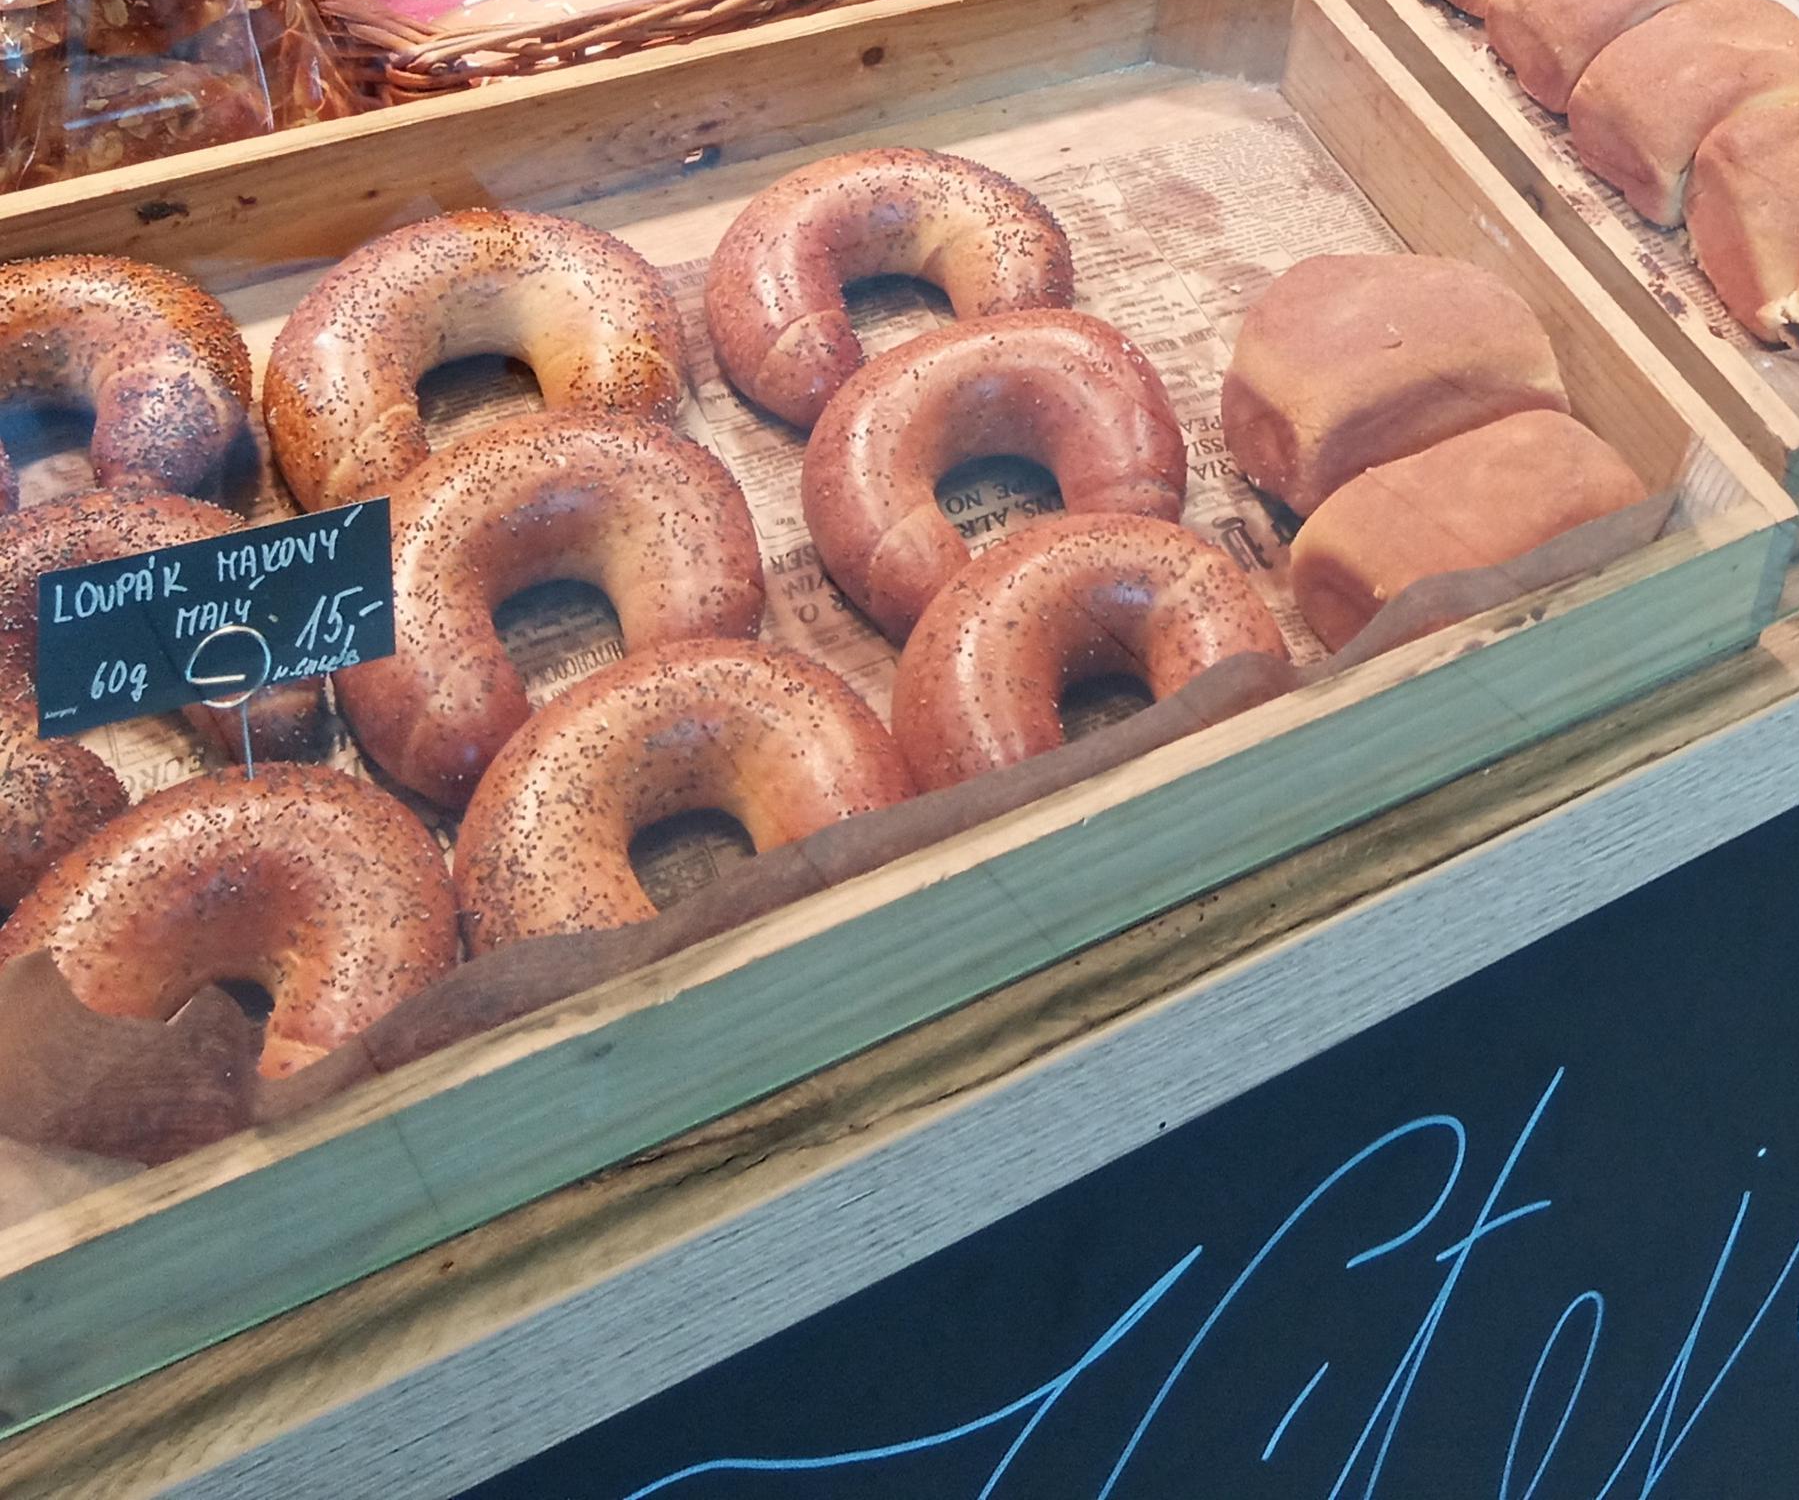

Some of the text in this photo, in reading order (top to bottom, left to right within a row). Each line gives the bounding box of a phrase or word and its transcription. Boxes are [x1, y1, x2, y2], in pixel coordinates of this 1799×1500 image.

[54, 505, 363, 623] LOUPÁK MAKOVÝ
[175, 576, 383, 660] MALÝ 15,-
[90, 660, 148, 702] 60g
